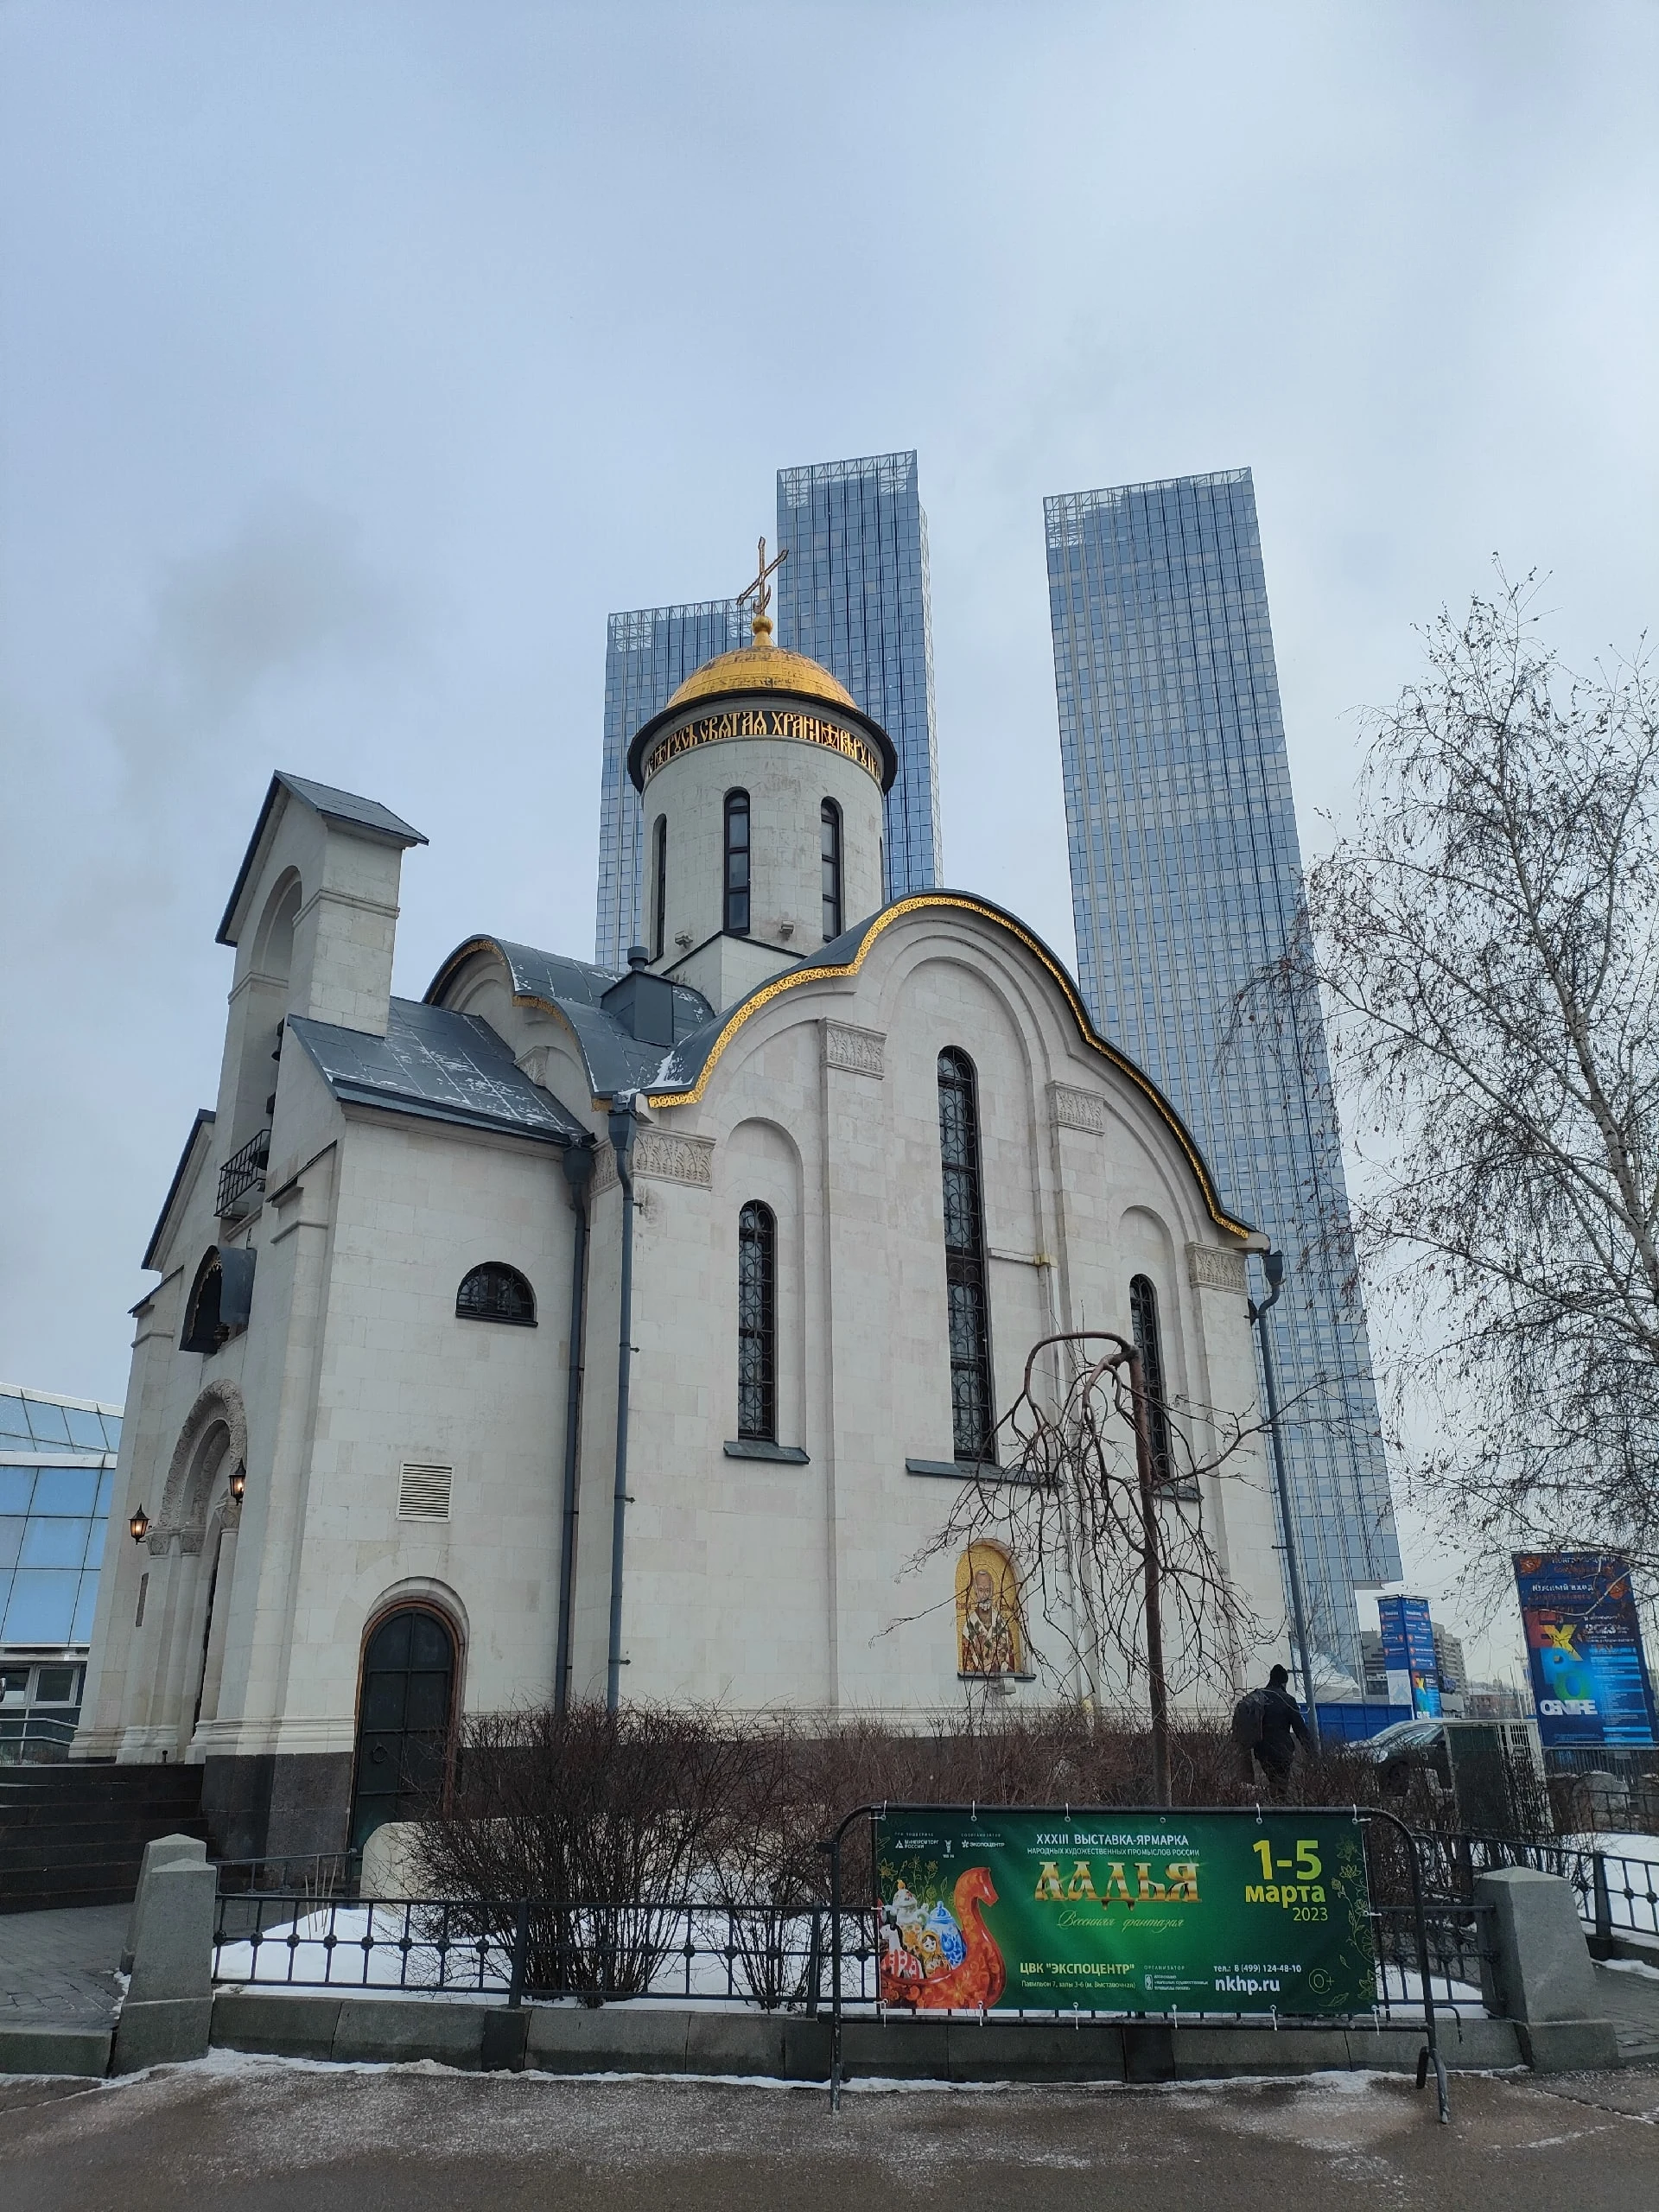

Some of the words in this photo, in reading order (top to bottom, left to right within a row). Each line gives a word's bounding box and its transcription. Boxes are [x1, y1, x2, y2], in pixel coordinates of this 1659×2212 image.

[1074, 1834, 1189, 1846] ВЫСТАВКА-ЯРМАРКА
[1065, 1847, 1127, 1856] ХУДОЖЕСТВЕННЫХ
[1034, 1860, 1202, 1911] ЛАДЬЯ
[1245, 1885, 1326, 1909] марта
[1293, 1907, 1328, 1922] 2023
[1020, 1962, 1044, 1975] ЦВК
[1046, 1963, 1135, 1977] "ЭКСПОЦЕНТР"
[1234, 1964, 1239, 1973] 8
[1241, 1964, 1261, 1974] (499)
[1021, 1980, 1052, 1988] Павильон
[1215, 1975, 1281, 1995] nkhp.ru
